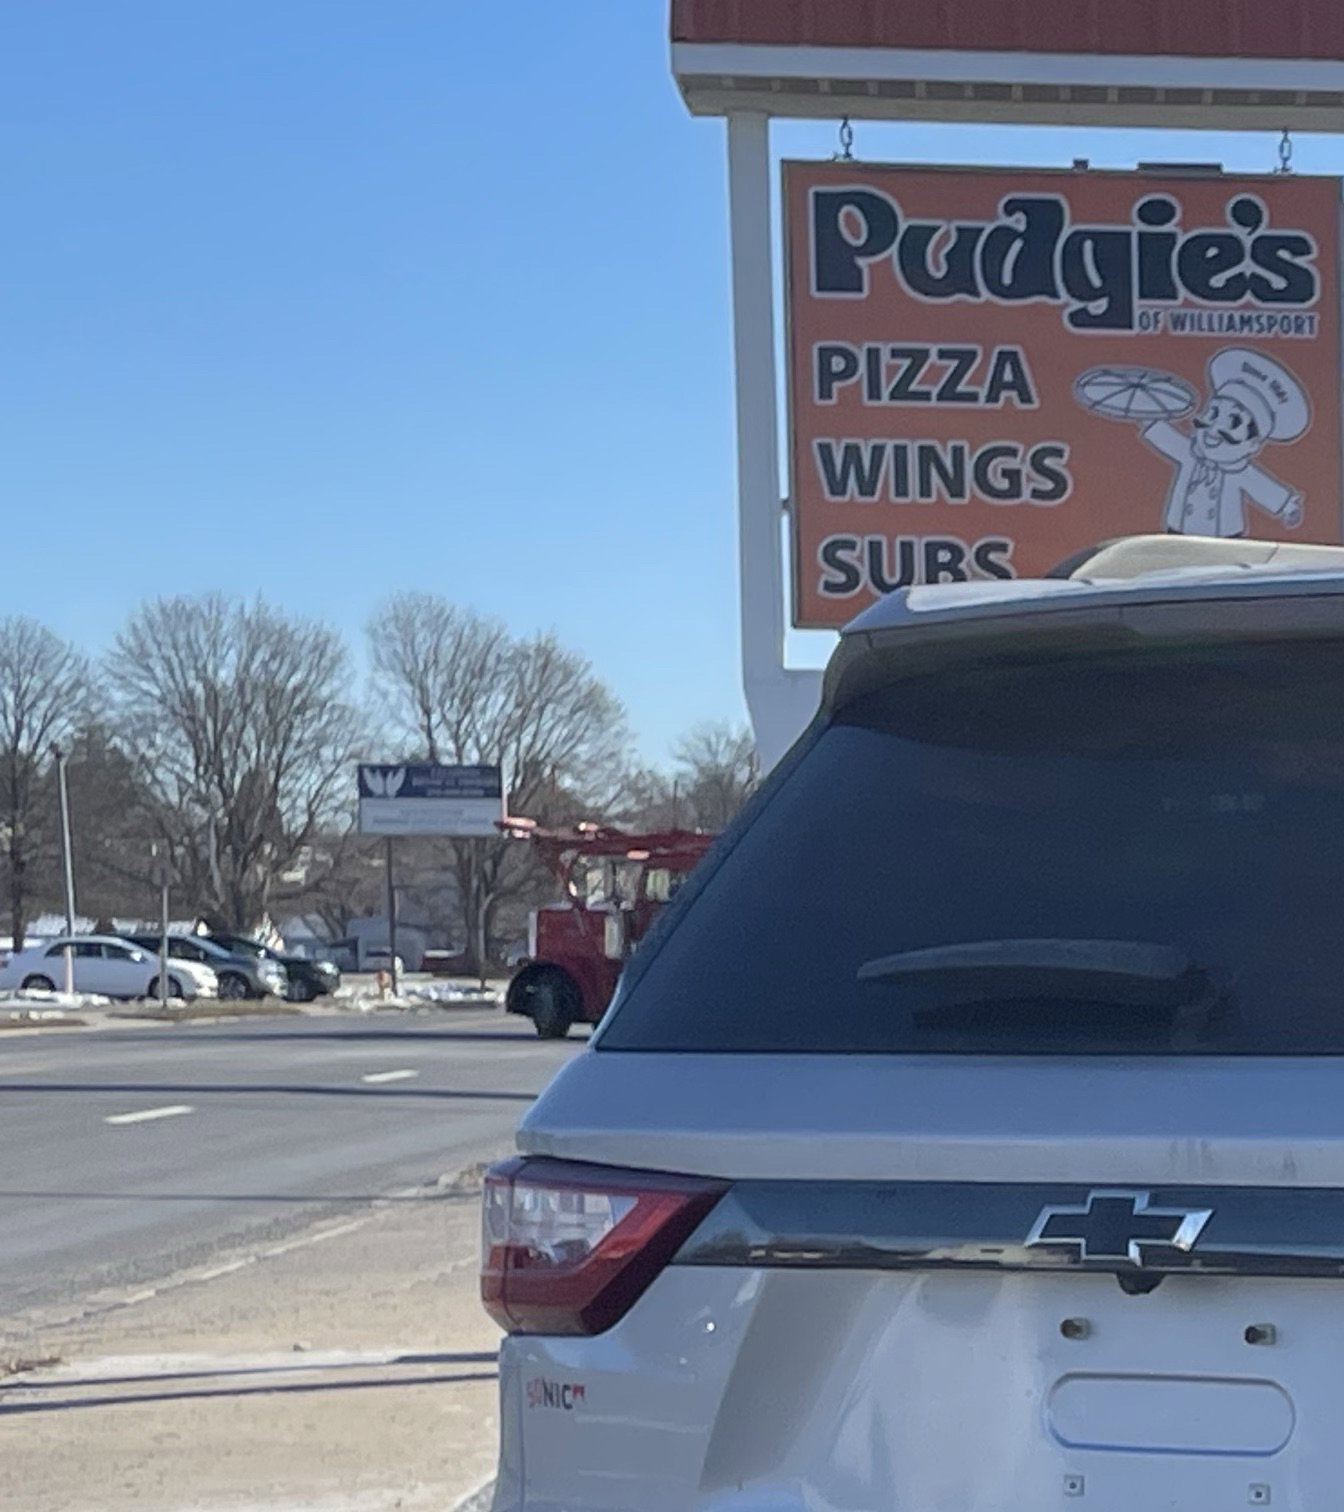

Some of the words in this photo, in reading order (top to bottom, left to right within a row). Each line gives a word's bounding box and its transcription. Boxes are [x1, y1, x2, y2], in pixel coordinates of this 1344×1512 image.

[811, 187, 1318, 333] Pudgie's
[1138, 310, 1162, 332] OF
[1168, 311, 1318, 335] WILLIAMSPORT
[815, 346, 1036, 405] PIZZA
[815, 441, 1069, 502] WINGS
[819, 537, 1013, 594] SUBS
